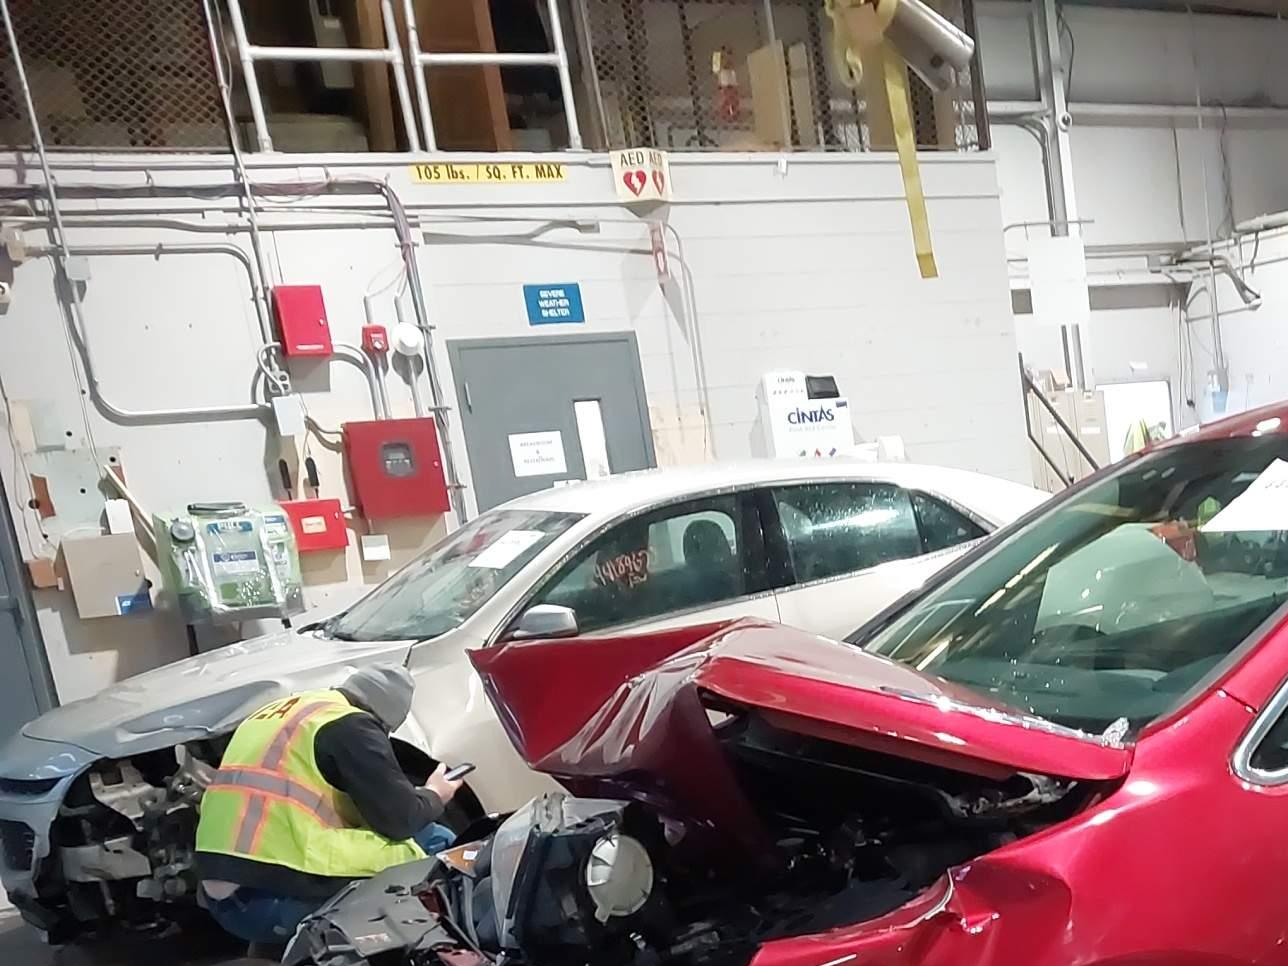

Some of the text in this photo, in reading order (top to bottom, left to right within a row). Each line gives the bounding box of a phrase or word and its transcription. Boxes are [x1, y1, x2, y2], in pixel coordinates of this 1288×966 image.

[620, 151, 644, 168] AED
[416, 165, 441, 180] 105
[447, 164, 470, 180] lbs.
[485, 164, 506, 181] SQ.
[512, 164, 530, 180] FT.
[535, 164, 564, 179] MAX
[787, 404, 835, 425] CINTAS
